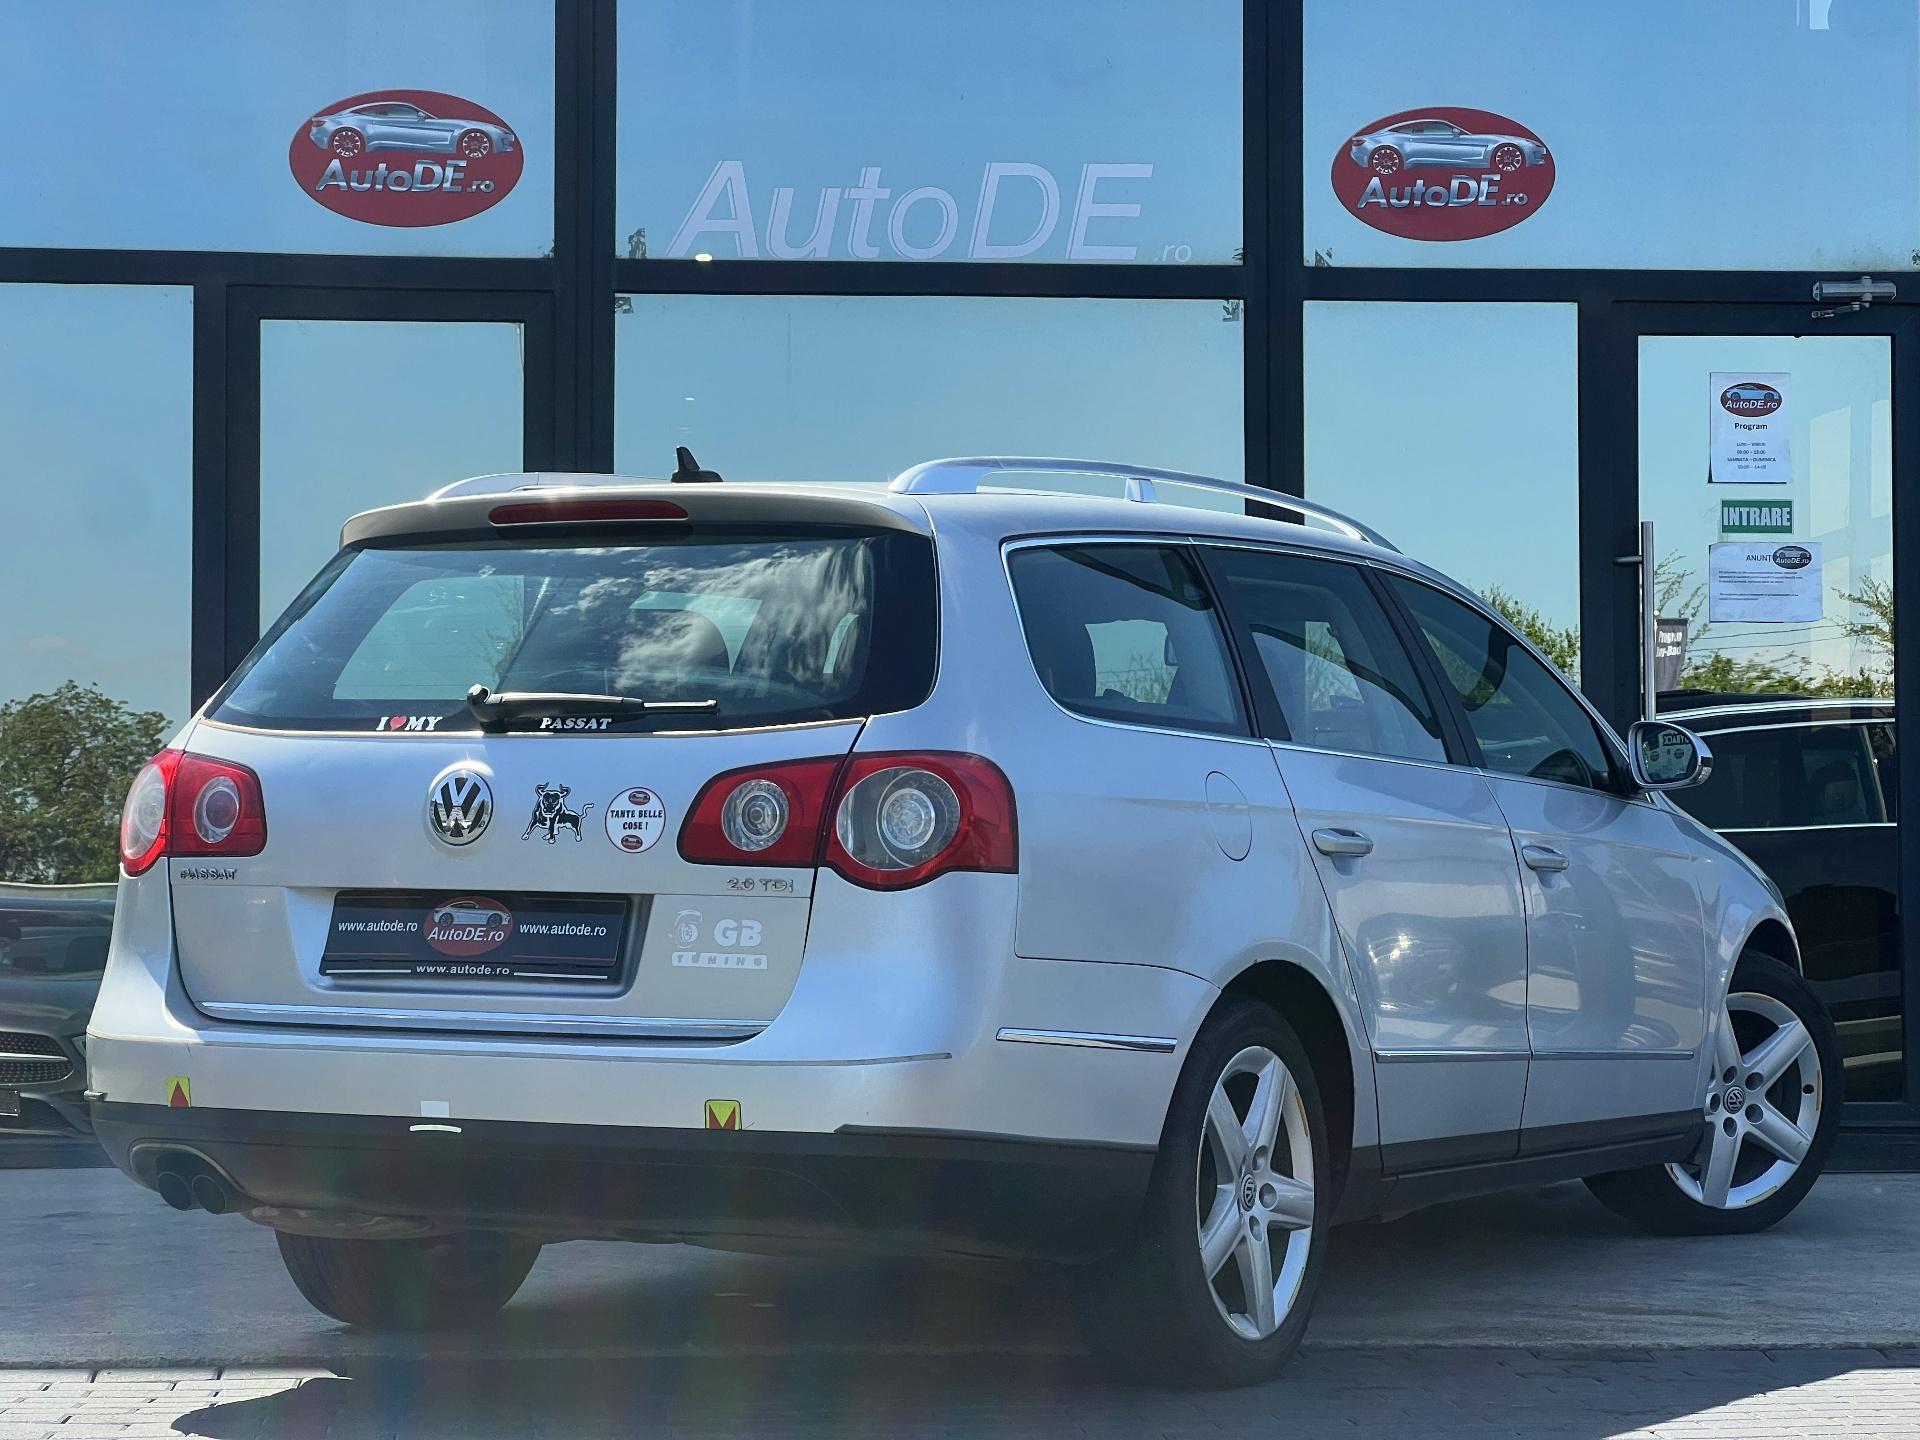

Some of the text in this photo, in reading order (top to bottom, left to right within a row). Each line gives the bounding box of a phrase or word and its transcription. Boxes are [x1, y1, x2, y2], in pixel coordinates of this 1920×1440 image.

[1725, 400, 1778, 409] AutoDE.ro
[1734, 422, 1768, 431] Program
[1722, 507, 1791, 526] INTRARE
[375, 716, 612, 731] I MY PASSAT
[610, 809, 663, 819] TANTE BELLE
[622, 821, 643, 830] COSE
[180, 868, 238, 880] PASSAT
[338, 919, 418, 932] www.autode.ro
[519, 922, 607, 937] www.autode.ro
[427, 926, 505, 942] AutoDE.ro
[713, 918, 762, 947] GB
[677, 953, 762, 967] TUNING
[416, 964, 510, 975] www.autode.ro
